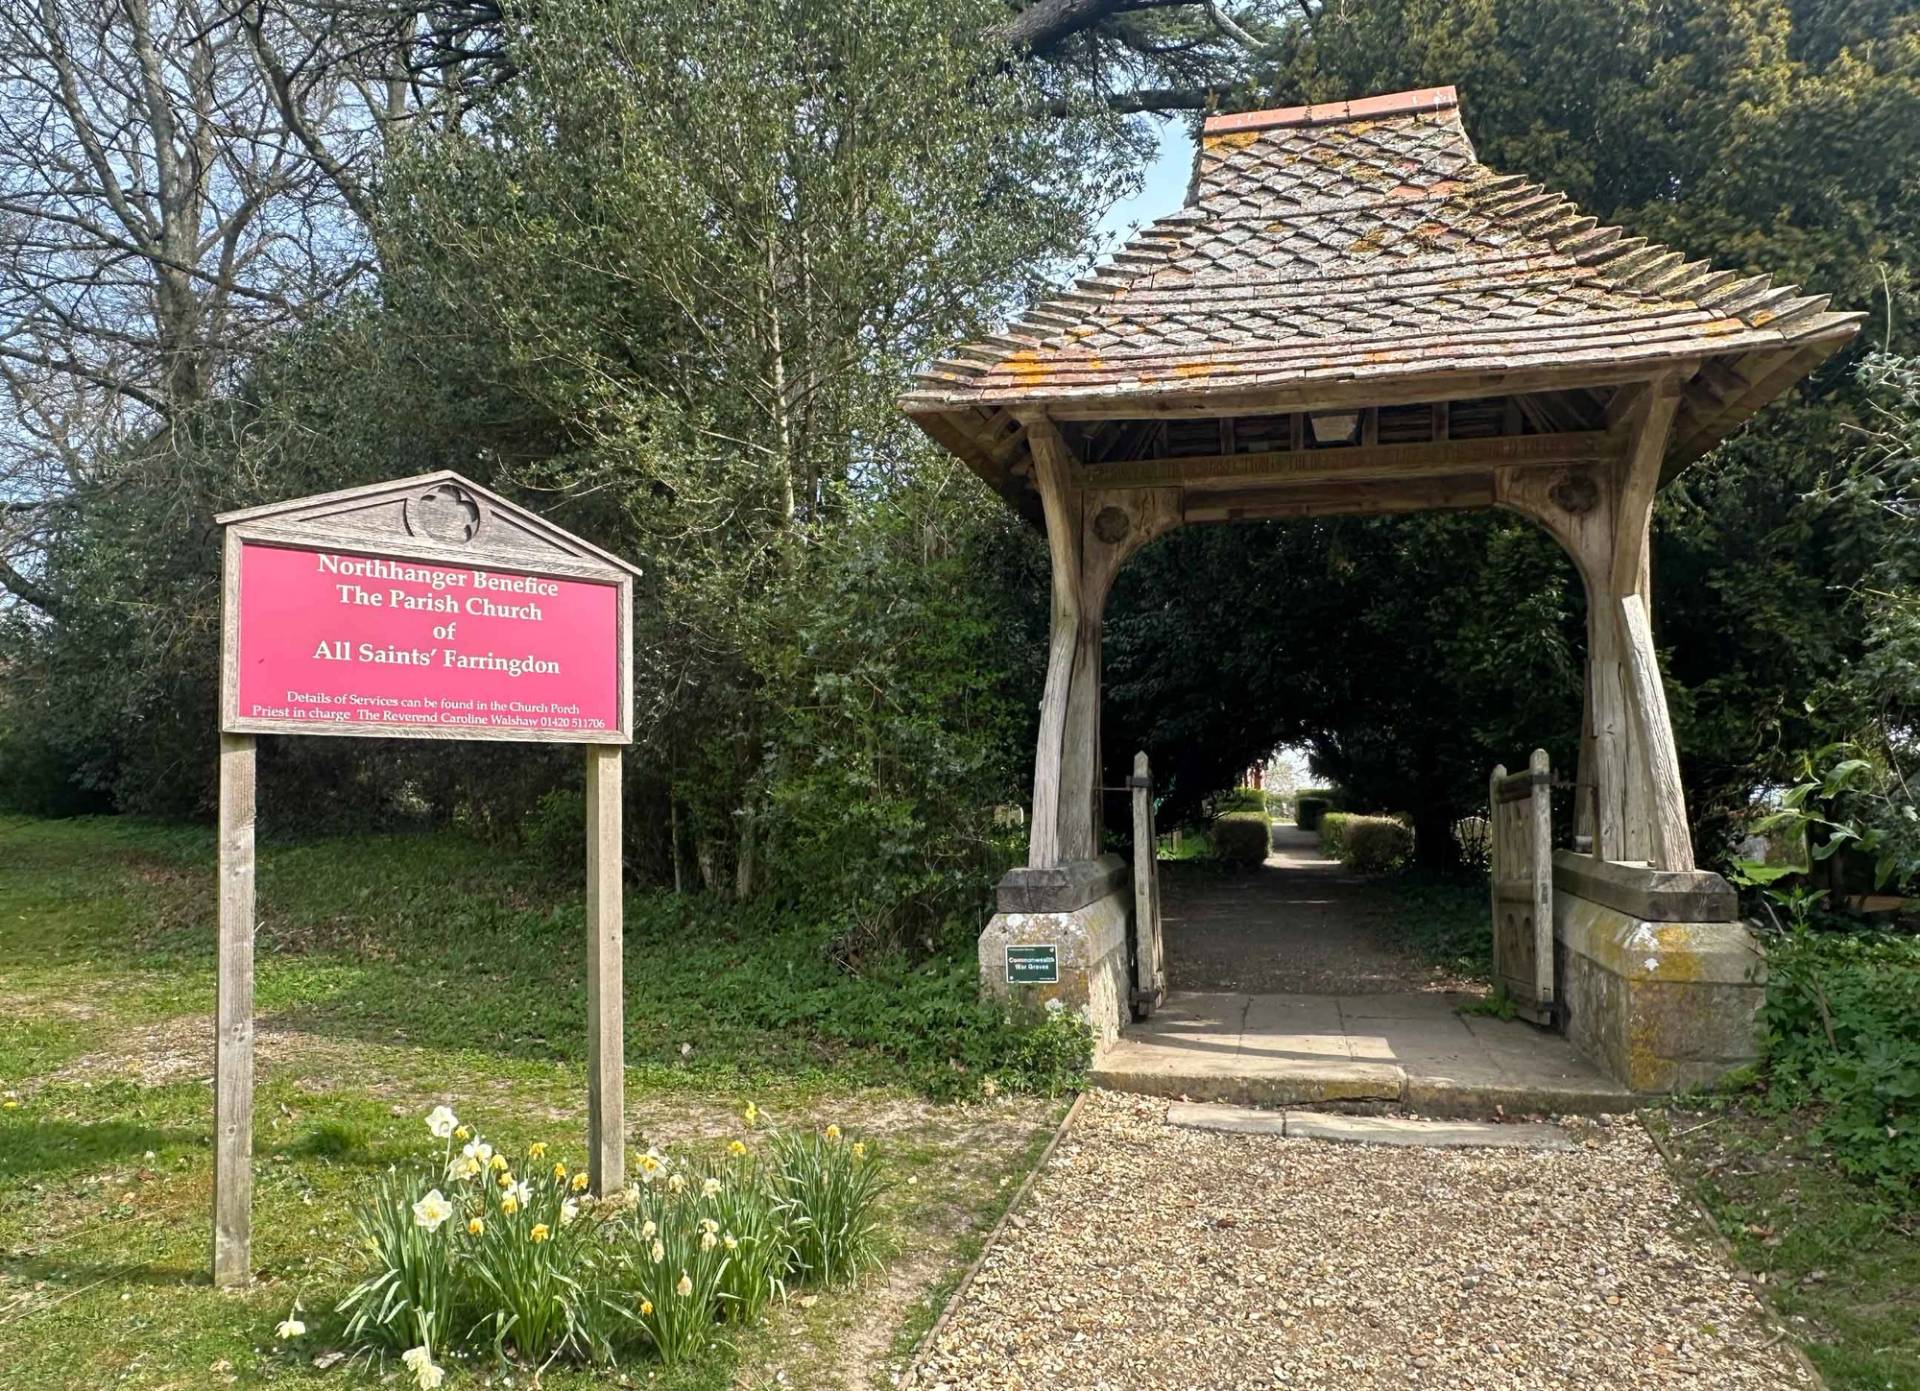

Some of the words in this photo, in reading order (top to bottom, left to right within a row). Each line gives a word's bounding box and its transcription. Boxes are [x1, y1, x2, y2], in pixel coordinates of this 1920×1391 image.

[316, 554, 468, 590] Northhanger
[472, 571, 559, 597] Benefice
[336, 584, 383, 606] The
[389, 589, 460, 614] Parish
[465, 597, 543, 621] Church
[432, 622, 457, 640] of
[313, 640, 351, 661] All
[443, 649, 561, 677] Farringdon
[252, 705, 290, 718] Priest
[293, 706, 305, 718] in
[308, 707, 351, 721] charge
[357, 709, 380, 720] The
[383, 712, 438, 723] Reverend
[440, 714, 488, 725] Caroline
[491, 715, 538, 727] Walshaw
[540, 716, 569, 727] 01420
[571, 717, 605, 729] 511706
[286, 691, 332, 704] Details
[334, 693, 348, 704] of
[348, 694, 398, 707] Services
[400, 699, 422, 707] can
[424, 698, 437, 708] be
[440, 698, 473, 710] found
[476, 701, 487, 710] in
[490, 701, 509, 711] the
[509, 701, 548, 713] Church
[551, 704, 580, 715] Porch
